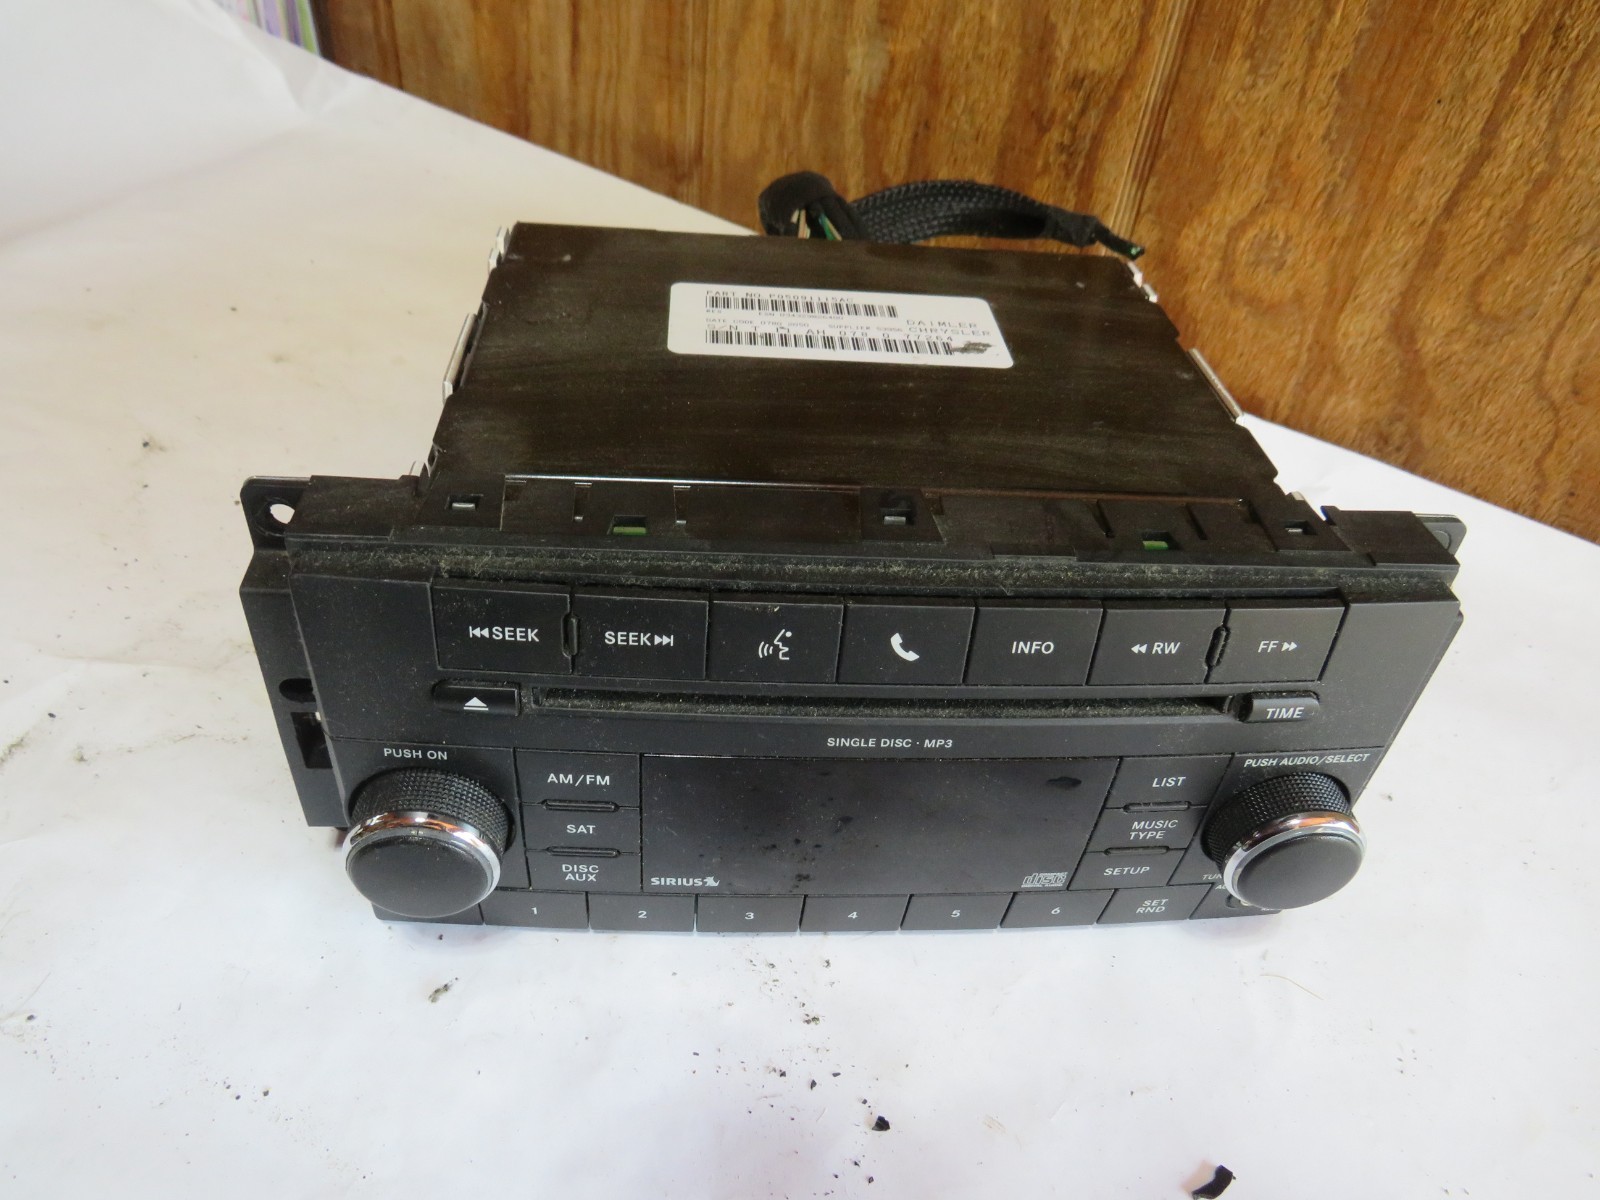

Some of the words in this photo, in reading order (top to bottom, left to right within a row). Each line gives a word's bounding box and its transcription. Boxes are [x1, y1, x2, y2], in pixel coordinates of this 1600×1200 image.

[706, 290, 736, 298] PART
[906, 319, 978, 329] DAIMLER
[908, 327, 992, 337] CHRYSLER
[492, 626, 540, 642] SEEK
[604, 631, 652, 647] SEEK
[1011, 640, 1055, 655] INFO
[1152, 641, 1180, 655] RW
[1257, 640, 1279, 653] FF
[1265, 706, 1305, 720] TIME
[826, 737, 877, 748] SINGLE
[880, 737, 913, 749] DISC
[923, 738, 954, 749] MP3
[383, 747, 425, 760] PUSH
[427, 749, 448, 761] ON
[1244, 757, 1281, 768] PUSH
[1281, 752, 1371, 767] AUDIO/SELECT
[547, 772, 611, 786] AM/FM
[1152, 776, 1187, 788] LIST
[566, 824, 596, 835] SAT
[1131, 819, 1179, 831] MUSIC
[1129, 830, 1167, 841] TYPE
[562, 864, 600, 874] DISC
[1103, 866, 1150, 877] SETUP
[565, 873, 598, 883] AUX
[650, 876, 704, 887] SIRIUS
[1141, 898, 1169, 908] SET
[531, 906, 538, 915] 1
[637, 910, 648, 919] 2
[950, 909, 961, 919] 5
[1050, 906, 1062, 916] 6
[1135, 904, 1166, 915] RND
[744, 911, 755, 920] 3
[847, 911, 859, 920] 4
